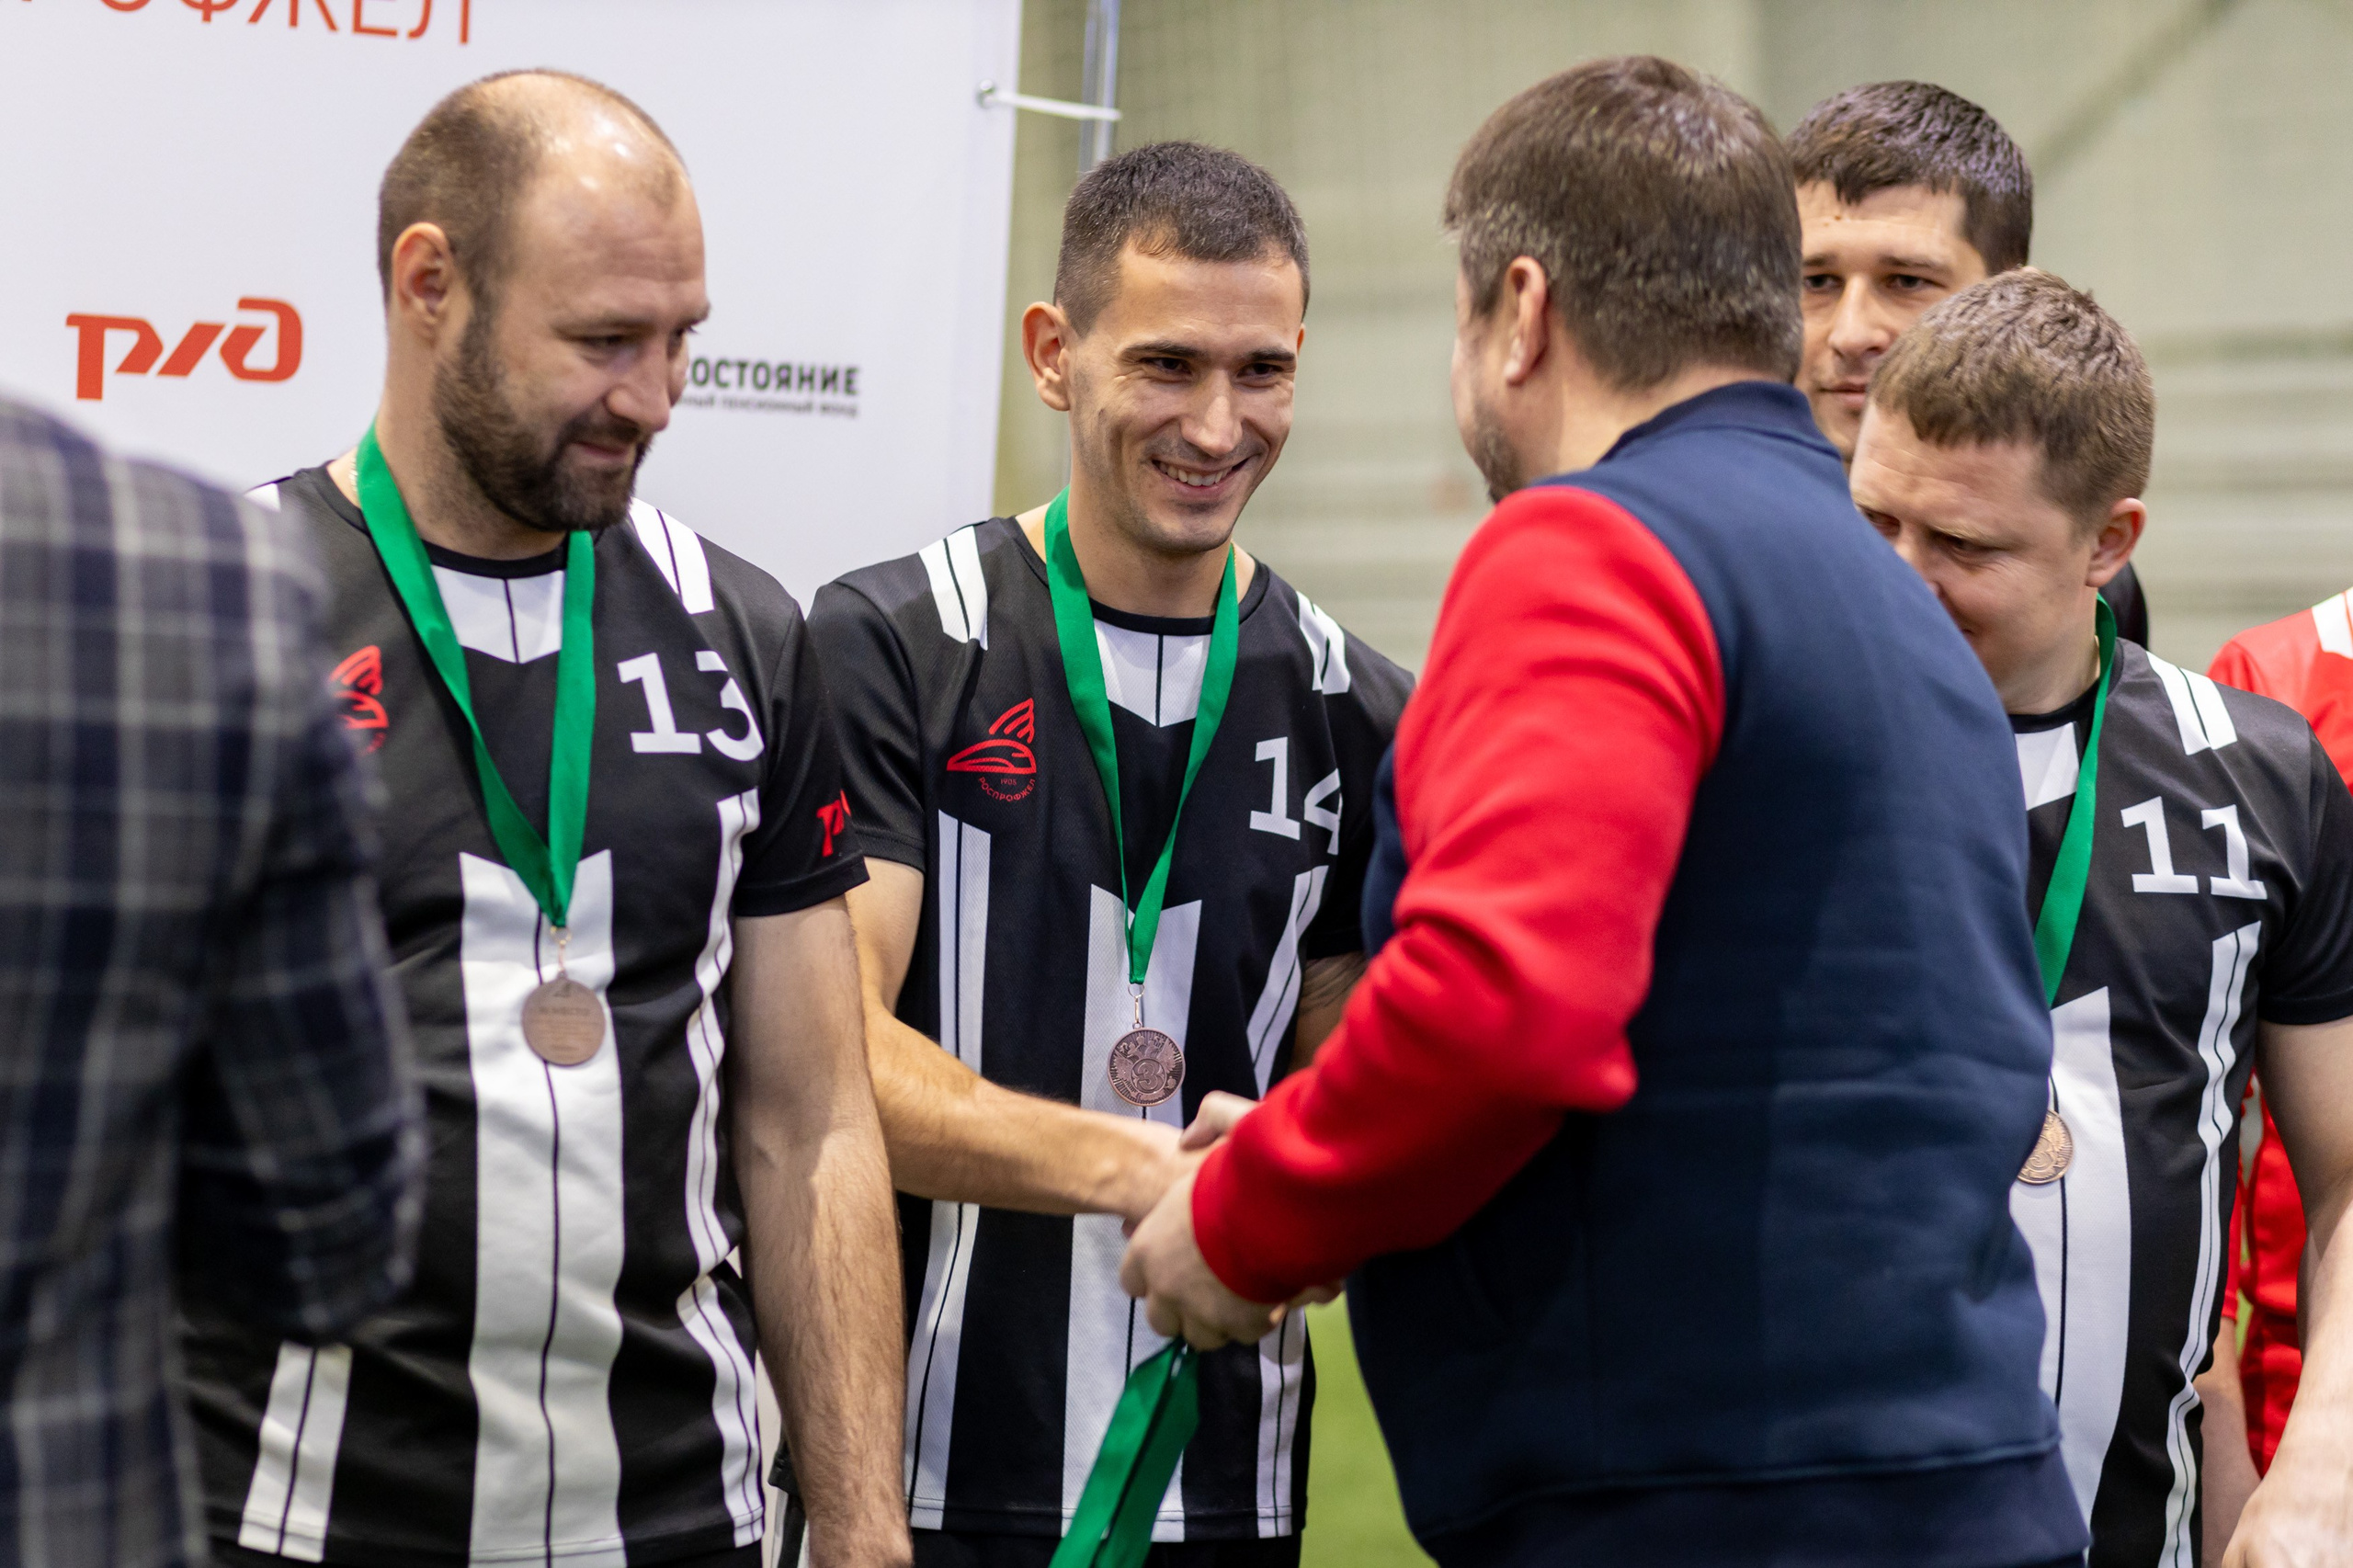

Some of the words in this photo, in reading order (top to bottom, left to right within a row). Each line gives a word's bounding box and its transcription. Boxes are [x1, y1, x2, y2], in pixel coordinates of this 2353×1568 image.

[684, 357, 860, 396] ОСТОЯНИЕ
[617, 650, 765, 761] 13
[979, 776, 1036, 801] РОСПРОФЖЕЛ
[1249, 736, 1344, 856] 14
[2120, 796, 2268, 900] 11
[1137, 1062, 1159, 1092] 3
